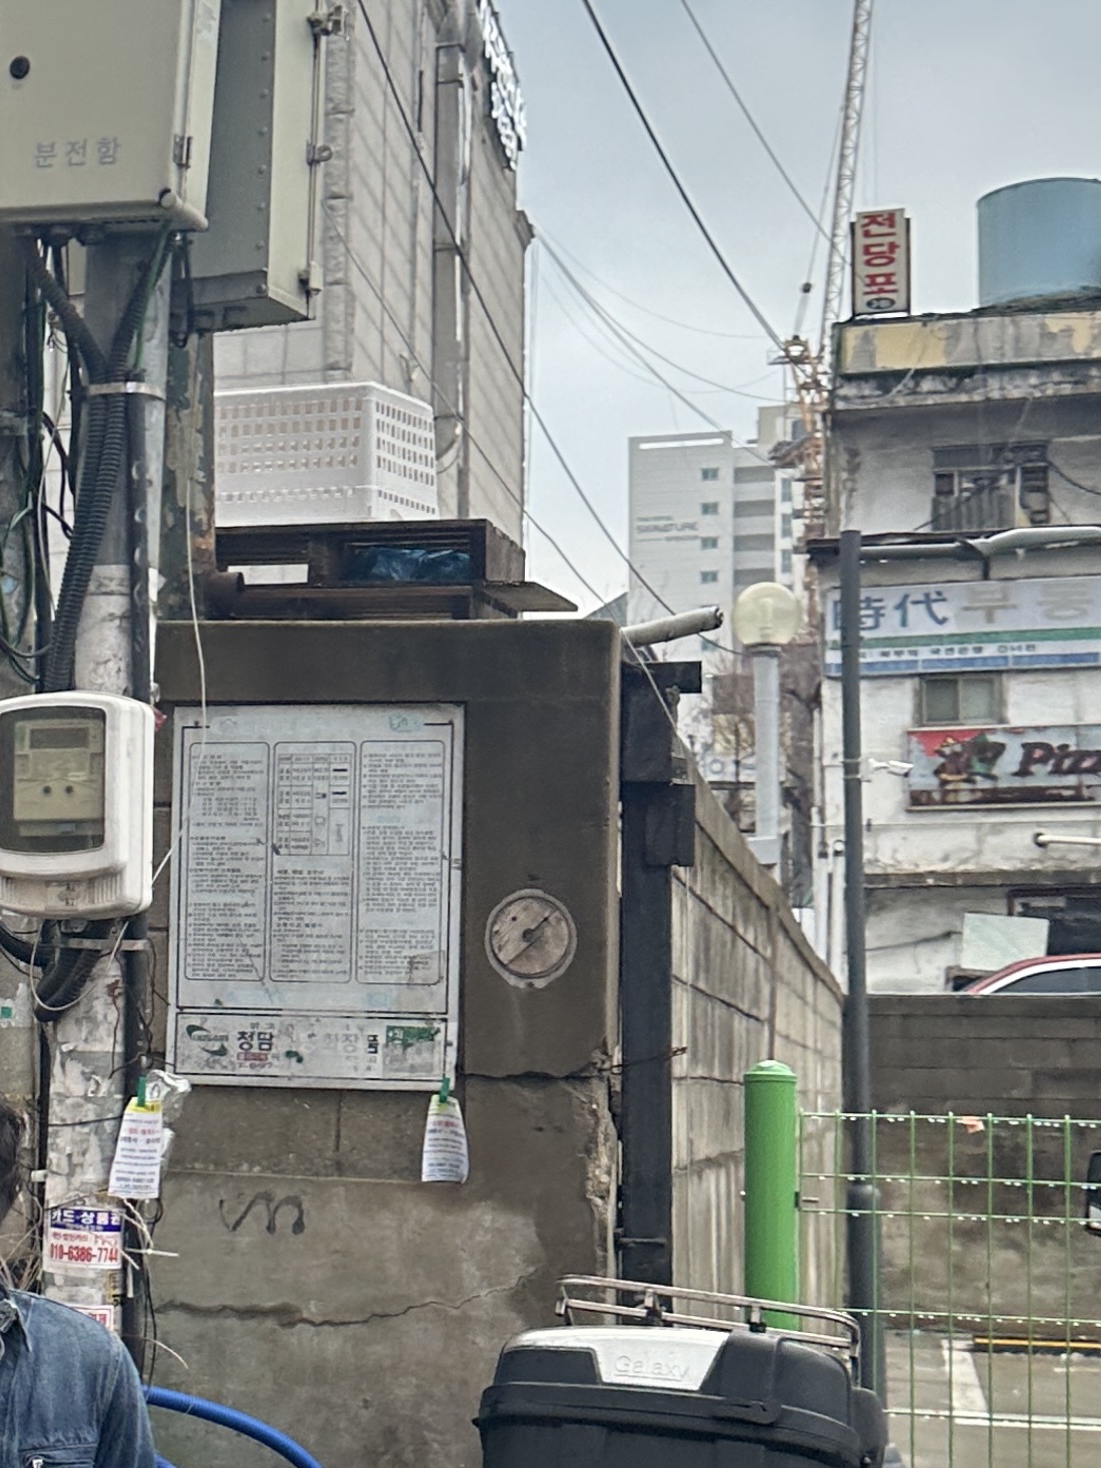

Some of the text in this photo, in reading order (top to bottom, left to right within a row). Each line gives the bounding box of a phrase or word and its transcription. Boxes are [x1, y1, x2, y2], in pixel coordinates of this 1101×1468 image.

[34, 136, 121, 168] 분전함
[861, 211, 901, 296] 전당포
[50, 1243, 118, 1263] 010-6386-7744
[614, 1354, 690, 1379] Galaxy
